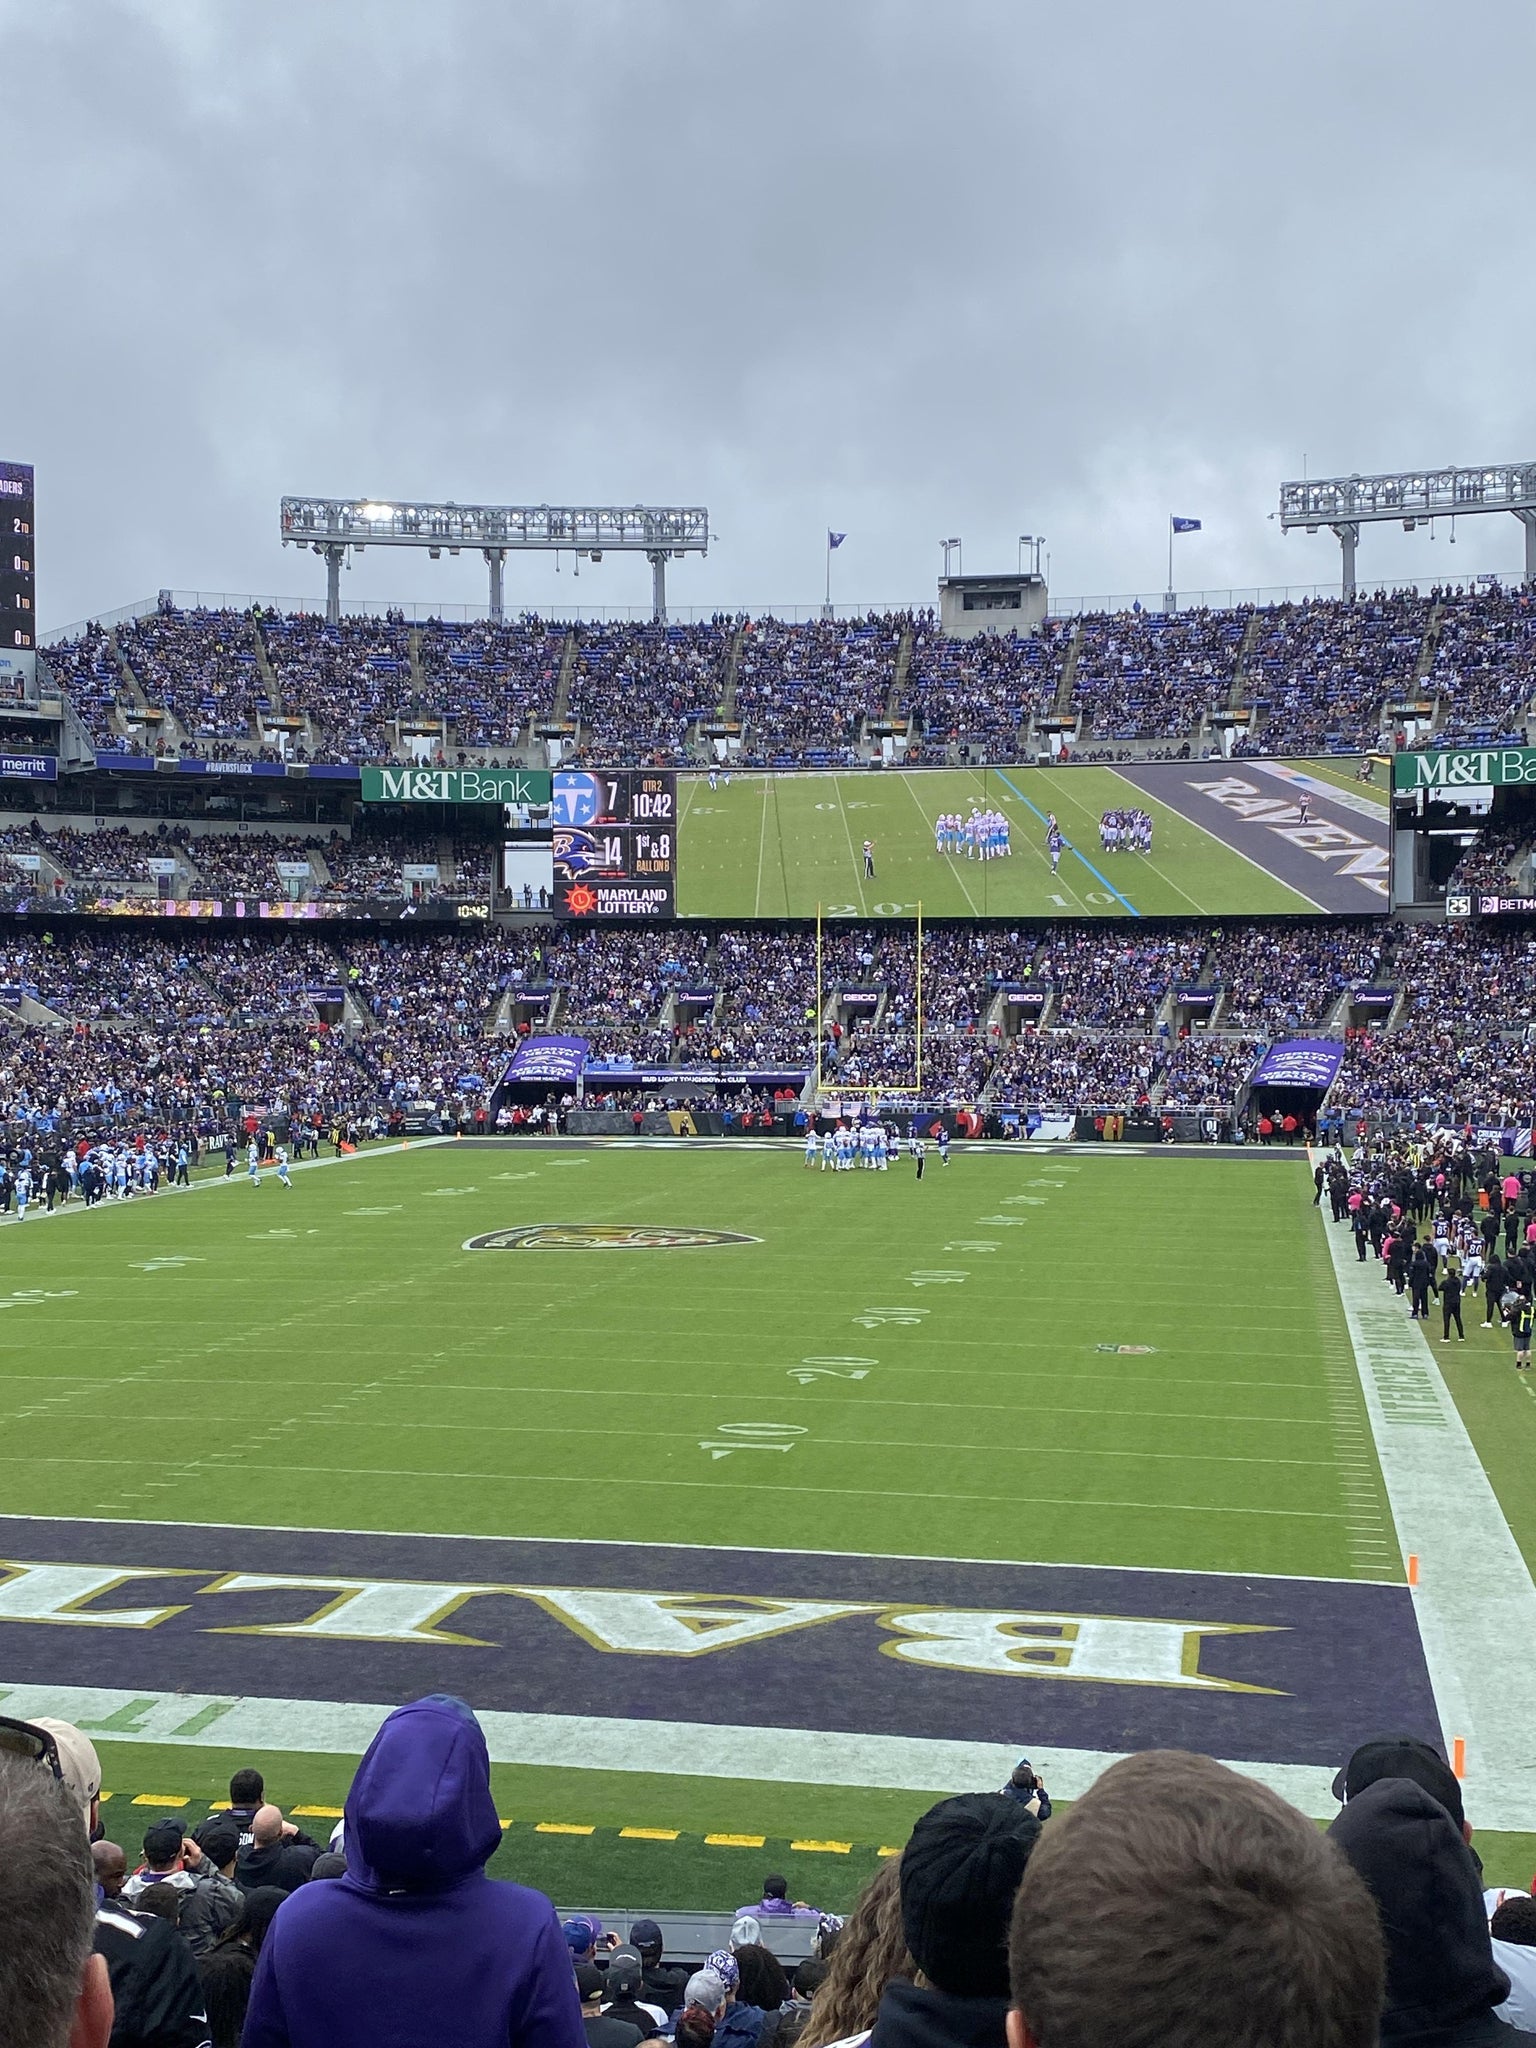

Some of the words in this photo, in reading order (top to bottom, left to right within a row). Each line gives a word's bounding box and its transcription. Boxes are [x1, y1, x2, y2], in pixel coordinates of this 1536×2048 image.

[2, 759, 46, 771] merritt
[206, 762, 253, 774] #RAVENSFLOCK
[1414, 751, 1498, 786] M&T
[380, 769, 459, 799] M&T
[460, 771, 532, 801] Bank
[642, 780, 656, 792] QTR
[657, 780, 662, 792] 2
[607, 781, 618, 810] 7
[632, 793, 671, 817] 10:42
[603, 836, 622, 865] 14
[650, 842, 659, 859] &
[659, 834, 670, 859] 8
[636, 859, 653, 872] BALL
[653, 859, 666, 872] ON
[597, 889, 667, 901] MARYLAND
[457, 905, 489, 918] 10:42
[1449, 901, 1468, 913] 25
[843, 993, 877, 1002] GEICO
[1008, 993, 1044, 1002] GEICO
[209, 1133, 229, 1150] RAVE
[1436, 1225, 1446, 1236] 85
[1469, 1244, 1482, 1255] 80
[852, 1307, 931, 1324] 30
[786, 1356, 880, 1380] 20
[1368, 1354, 1448, 1427] INTERCEPT
[698, 1422, 809, 1452] 10
